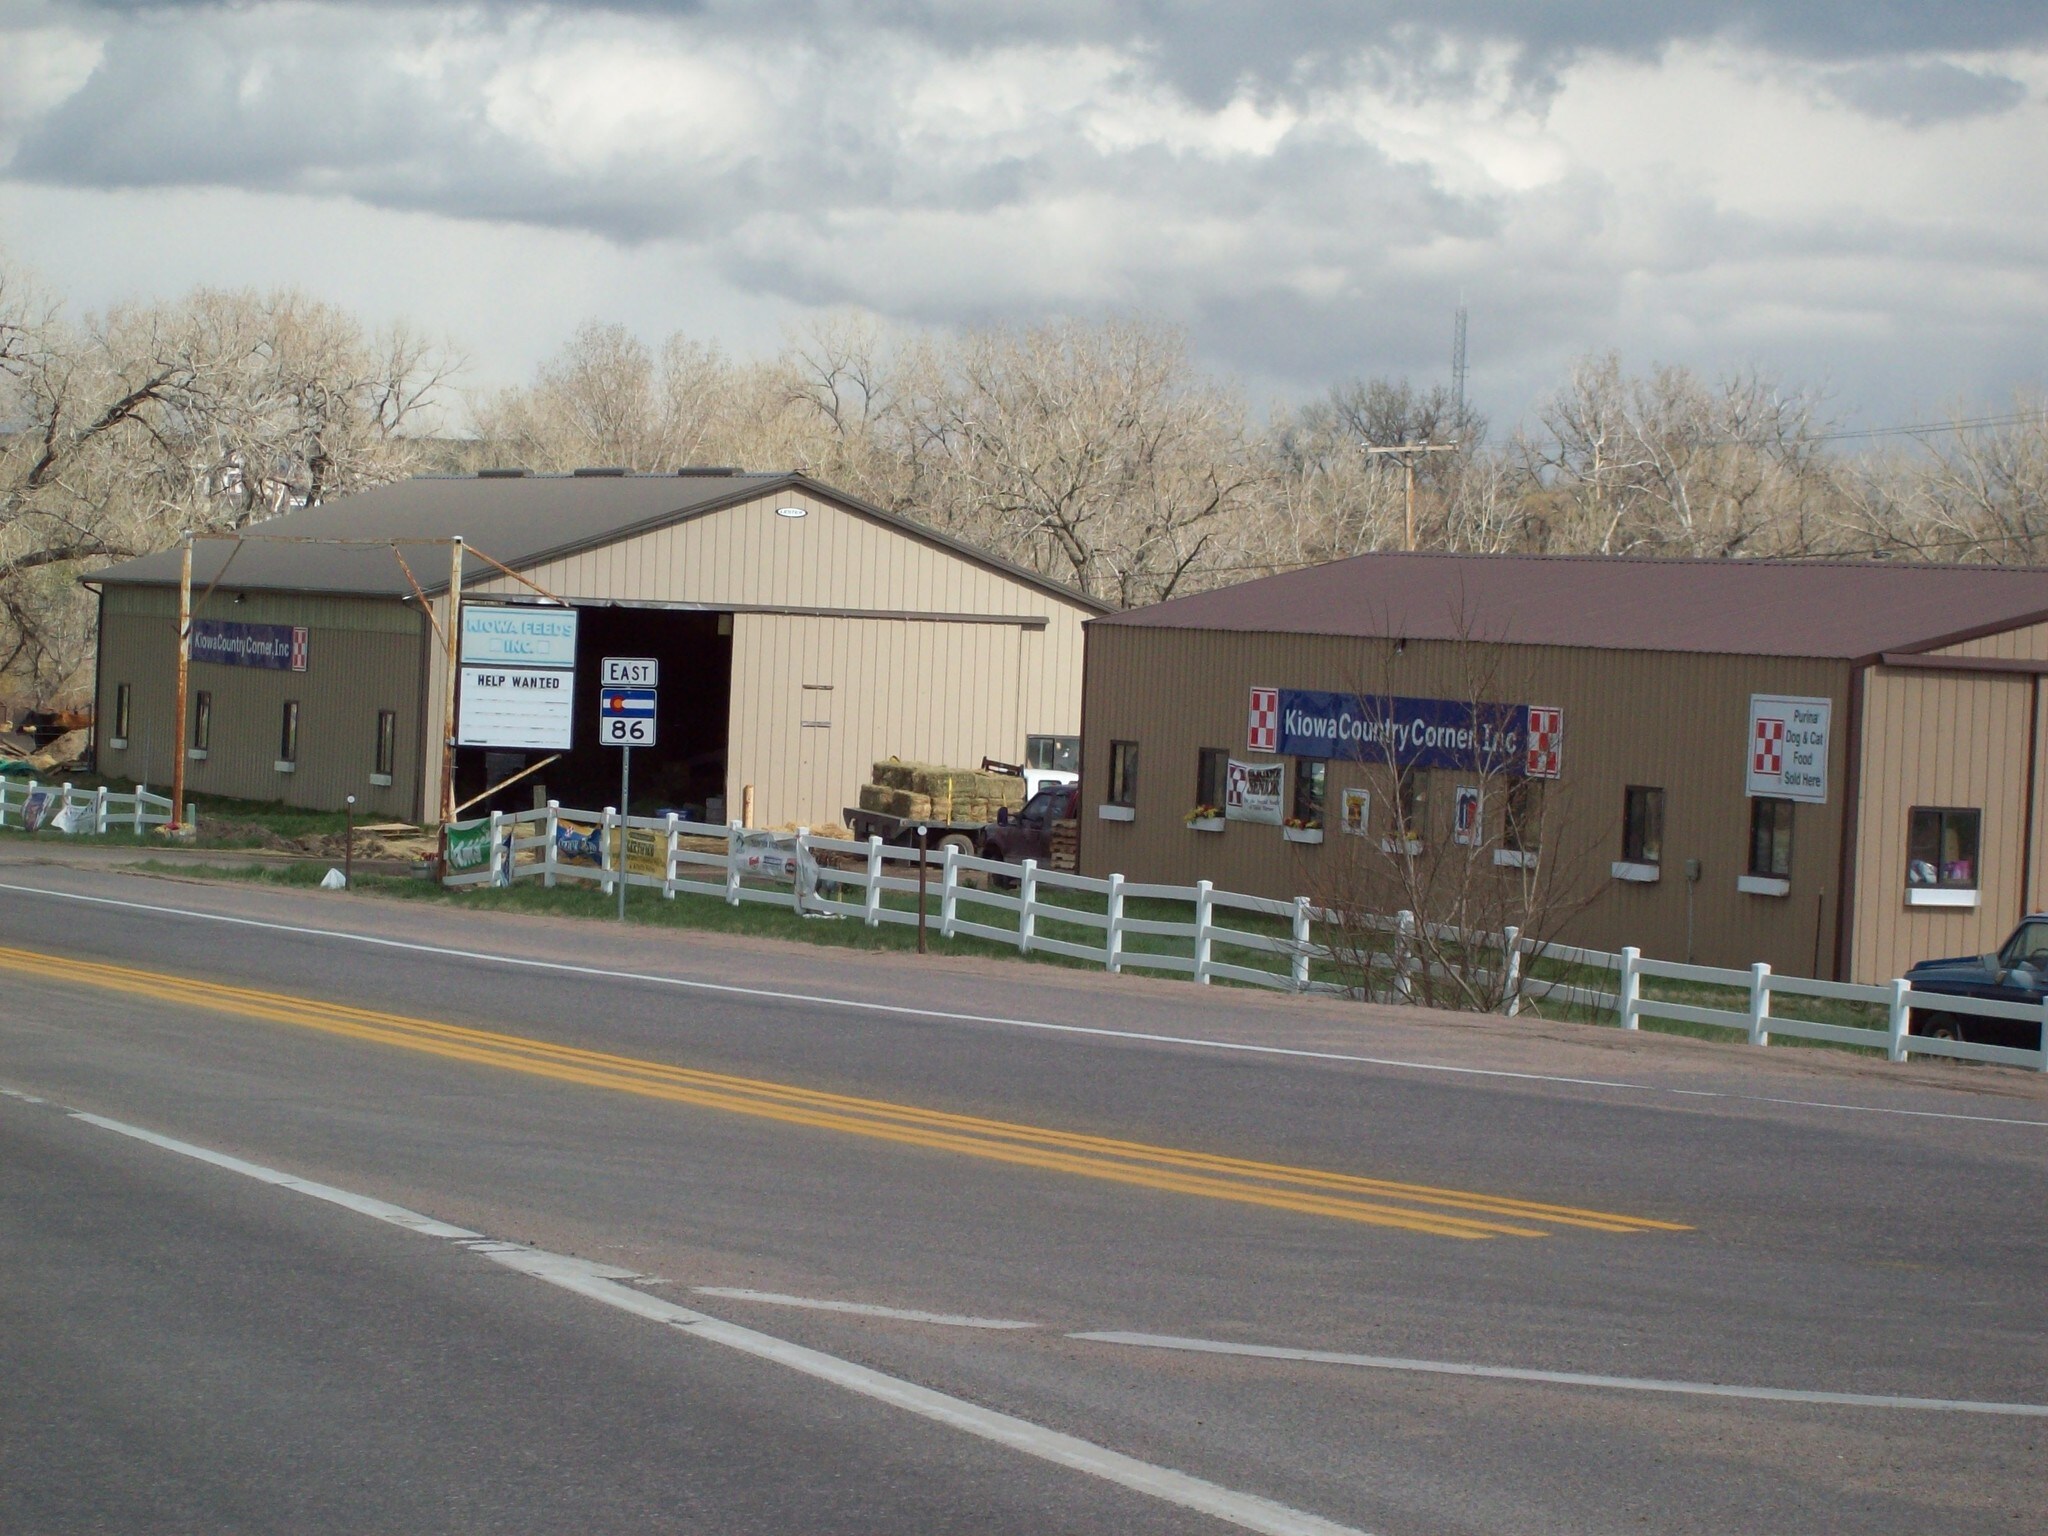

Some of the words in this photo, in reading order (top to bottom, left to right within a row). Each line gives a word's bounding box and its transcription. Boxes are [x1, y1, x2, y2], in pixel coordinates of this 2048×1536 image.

[521, 622, 572, 637] FEEDS
[503, 640, 534, 654] INC.
[610, 663, 649, 682] EAST
[477, 674, 506, 687] HELP
[512, 676, 560, 689] WANTED
[1793, 709, 1819, 724] Purina
[611, 720, 645, 740] 86
[1785, 730, 1801, 747] Dog
[1802, 732, 1808, 745] &
[1810, 731, 1823, 746] Cat
[1793, 751, 1813, 766] Food
[1784, 771, 1801, 786] Sold
[1802, 773, 1821, 788] Here
